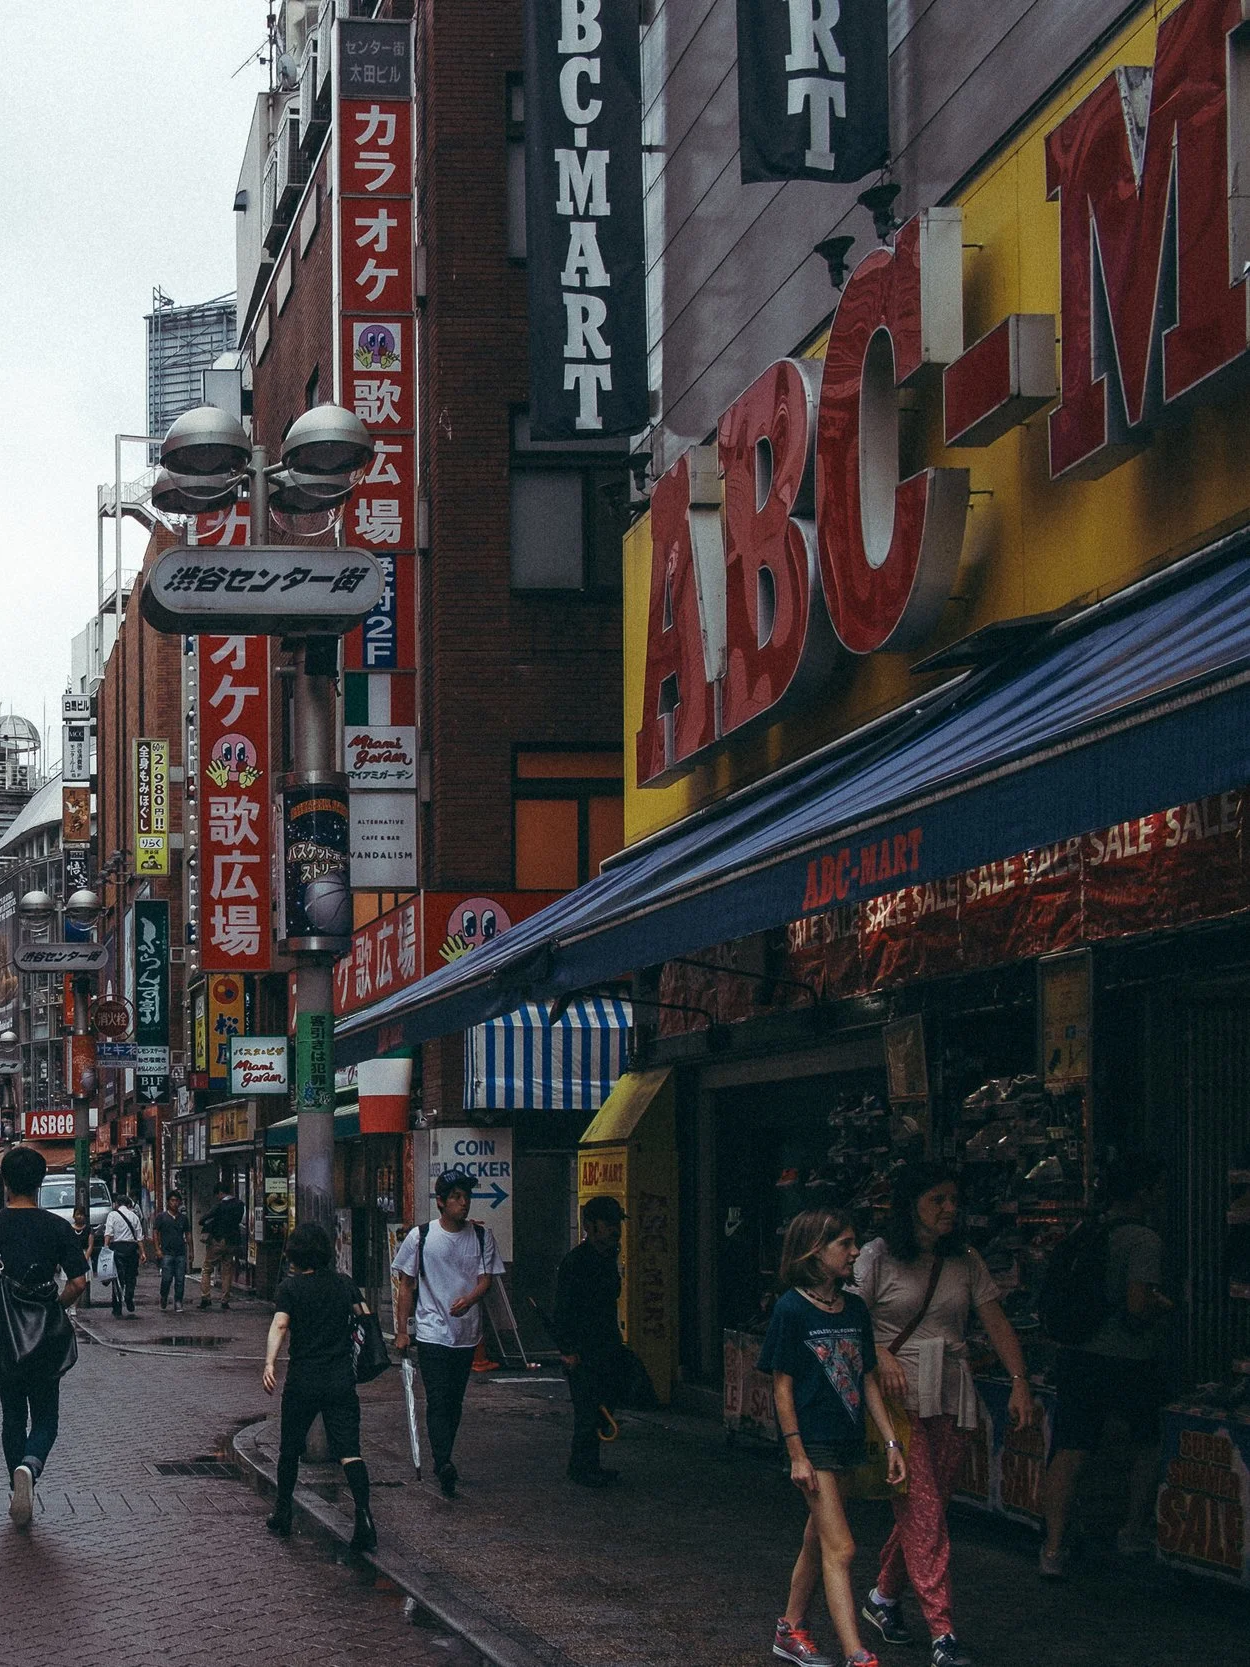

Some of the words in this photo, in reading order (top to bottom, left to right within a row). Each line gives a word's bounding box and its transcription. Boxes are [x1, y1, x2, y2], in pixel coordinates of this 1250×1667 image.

[346, 40, 405, 58] センター街
[350, 64, 400, 84] 太田ビル
[354, 104, 399, 302] カラオケ
[164, 566, 371, 594] 渋谷センター街
[348, 734, 403, 749] Miami
[348, 770, 413, 780] マイアミガーデン
[139, 745, 150, 831] 全身もみほぐし
[143, 838, 161, 848] りらく
[350, 851, 413, 860] VANDALISM
[209, 796, 261, 957] 歌広場
[802, 827, 924, 912] ABC-MART
[21, 950, 103, 963] 渋谷センター街
[233, 1060, 275, 1072] Miami
[141, 1076, 164, 1086] B1F
[454, 1140, 495, 1156] COIN
[443, 1161, 511, 1177] LOCKER
